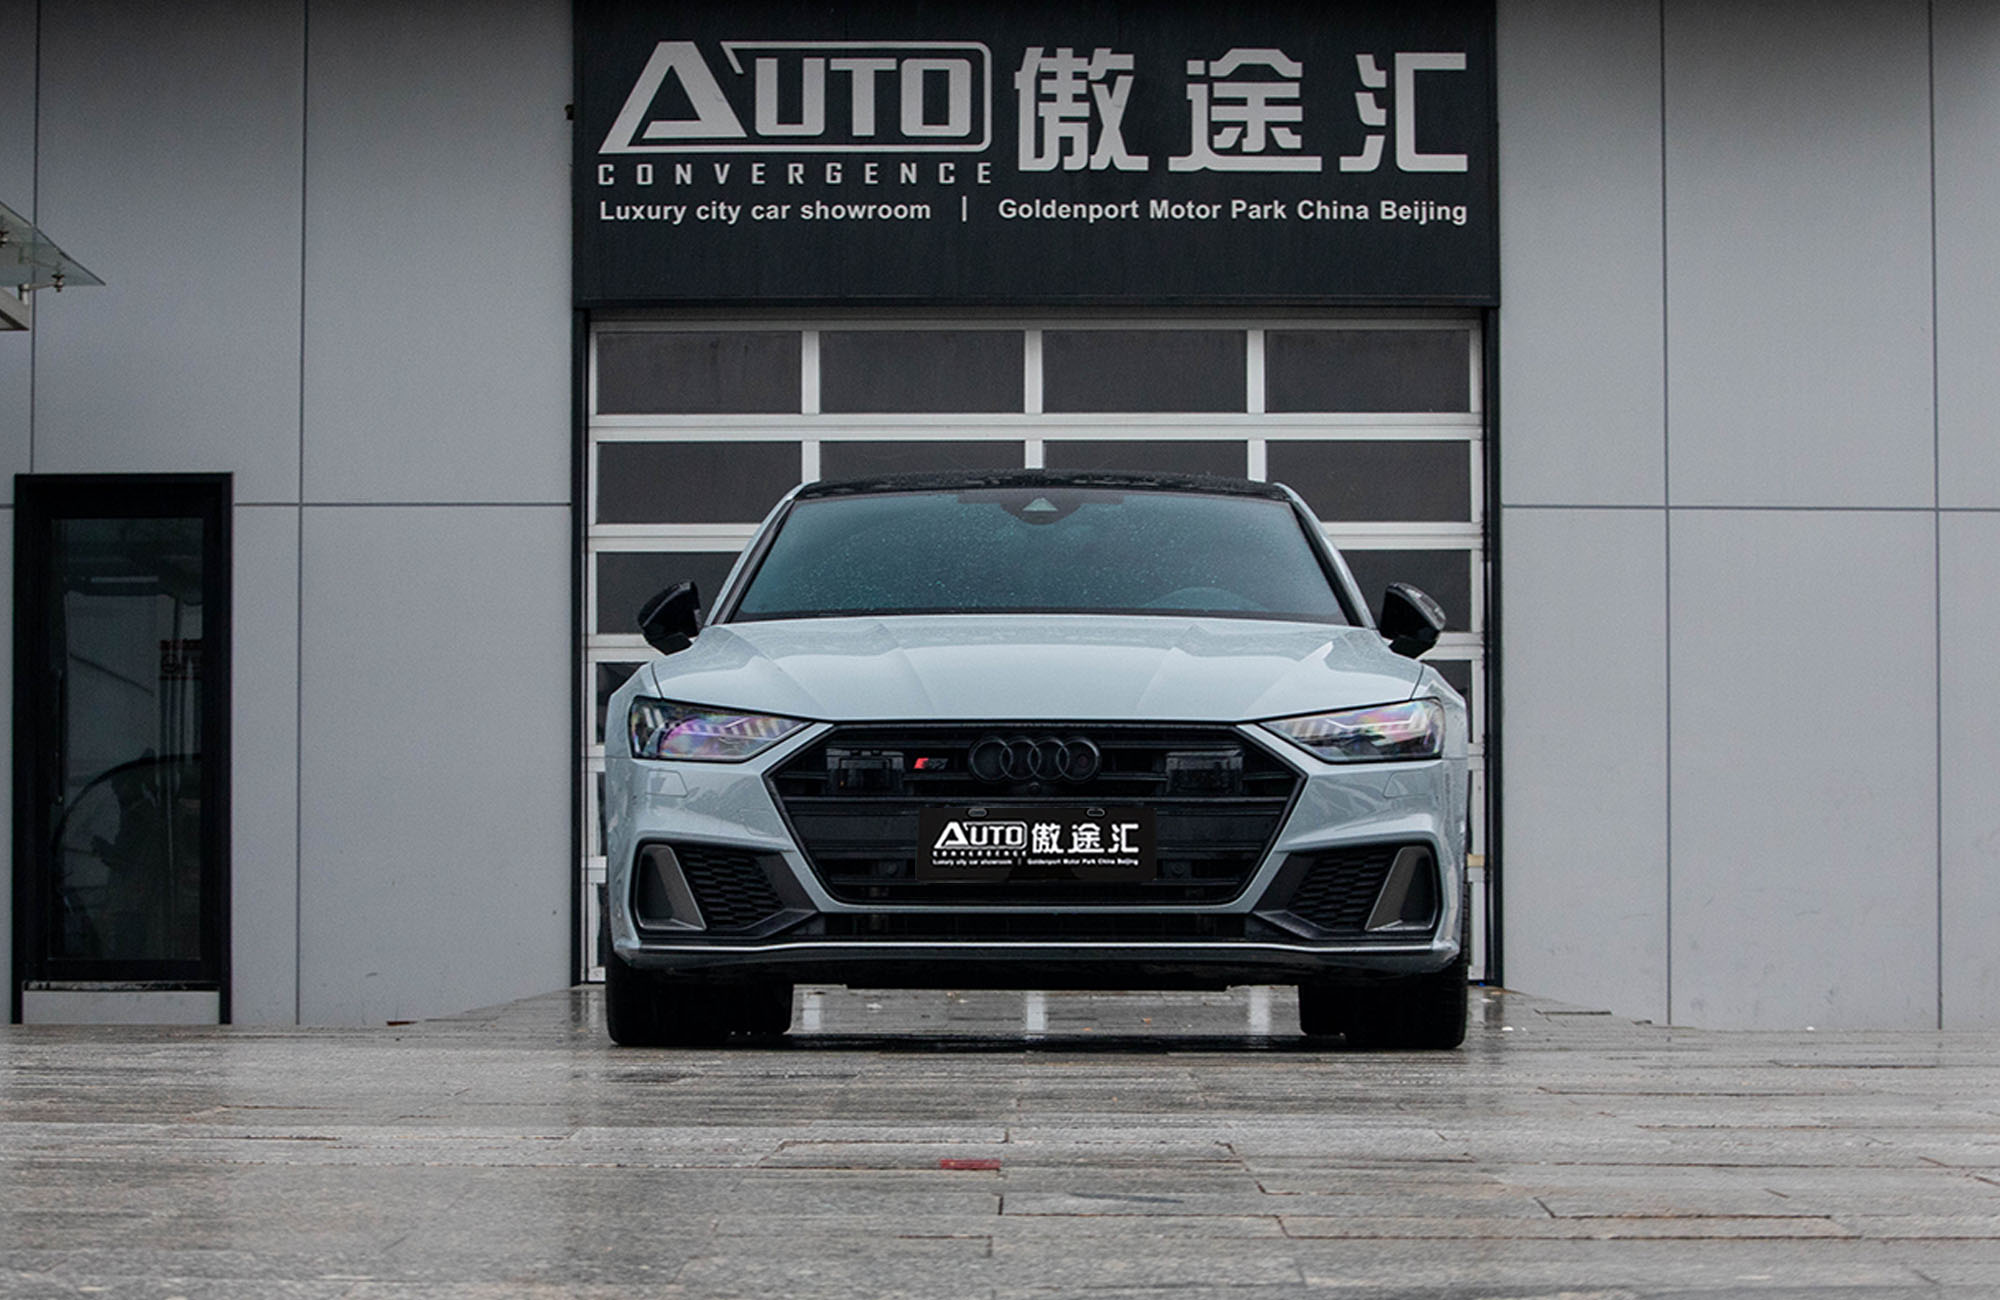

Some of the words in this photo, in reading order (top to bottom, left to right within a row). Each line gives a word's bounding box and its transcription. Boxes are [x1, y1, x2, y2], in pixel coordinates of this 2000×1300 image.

[599, 41, 991, 154] AUTO
[1014, 47, 1468, 172] 傲途汇
[598, 162, 992, 186] CONVERGENCE
[600, 200, 687, 225] Luxury
[696, 200, 742, 225] city
[750, 204, 792, 220] car
[800, 200, 931, 220] showroom
[998, 198, 1140, 224] Goldenport
[1149, 199, 1222, 220] Motor
[1231, 199, 1287, 220] Park
[1297, 199, 1370, 220] China
[1380, 200, 1468, 226] Beijing
[933, 821, 1028, 850] AUTO
[1031, 822, 1140, 854] 傲途汇
